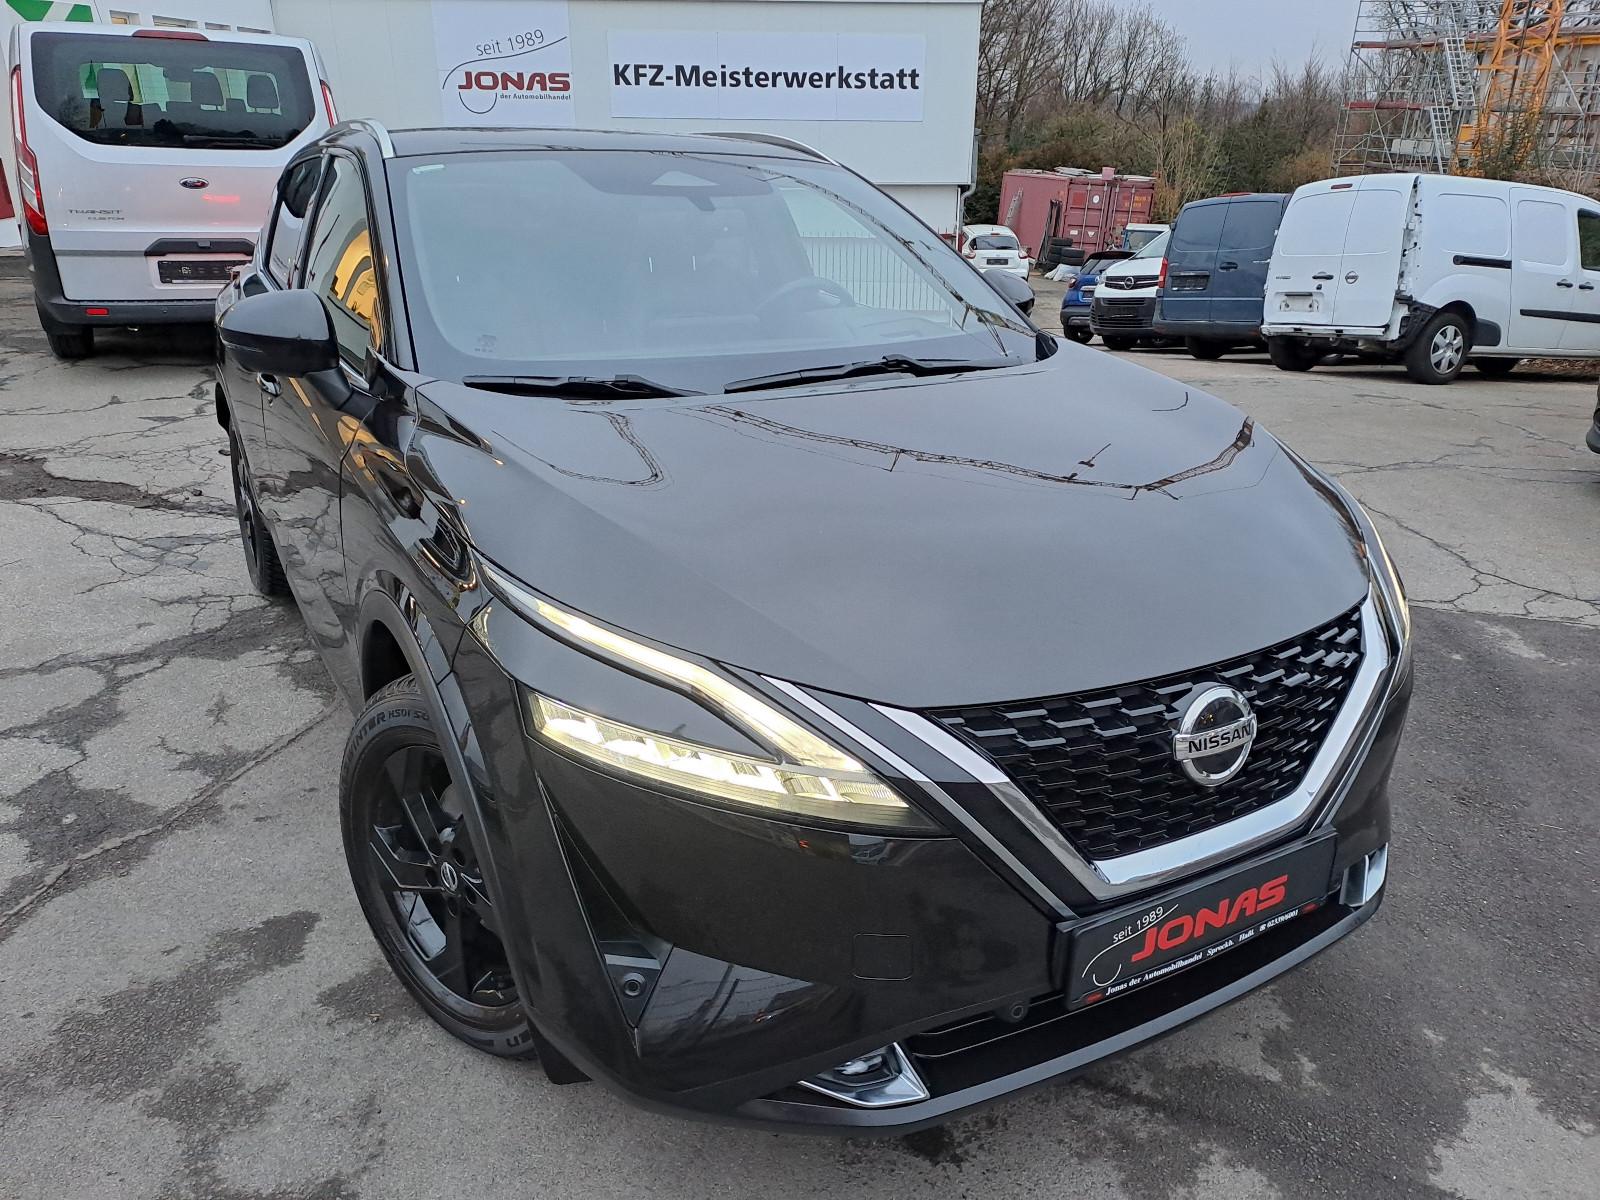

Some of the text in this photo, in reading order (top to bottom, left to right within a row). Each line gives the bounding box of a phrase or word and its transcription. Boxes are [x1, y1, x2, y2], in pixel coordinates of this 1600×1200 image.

[476, 29, 544, 56] seit 1989
[458, 71, 571, 91] JONAS
[613, 63, 920, 90] KFZ-Meisterwerkstatt
[1188, 725, 1251, 753] NISSAN
[1113, 906, 1164, 943] seit 1989
[1131, 875, 1288, 962] JONAS
[1106, 981, 1127, 996] Jonas
[1129, 976, 1141, 987] der
[1143, 952, 1203, 981] Automobilhandel
